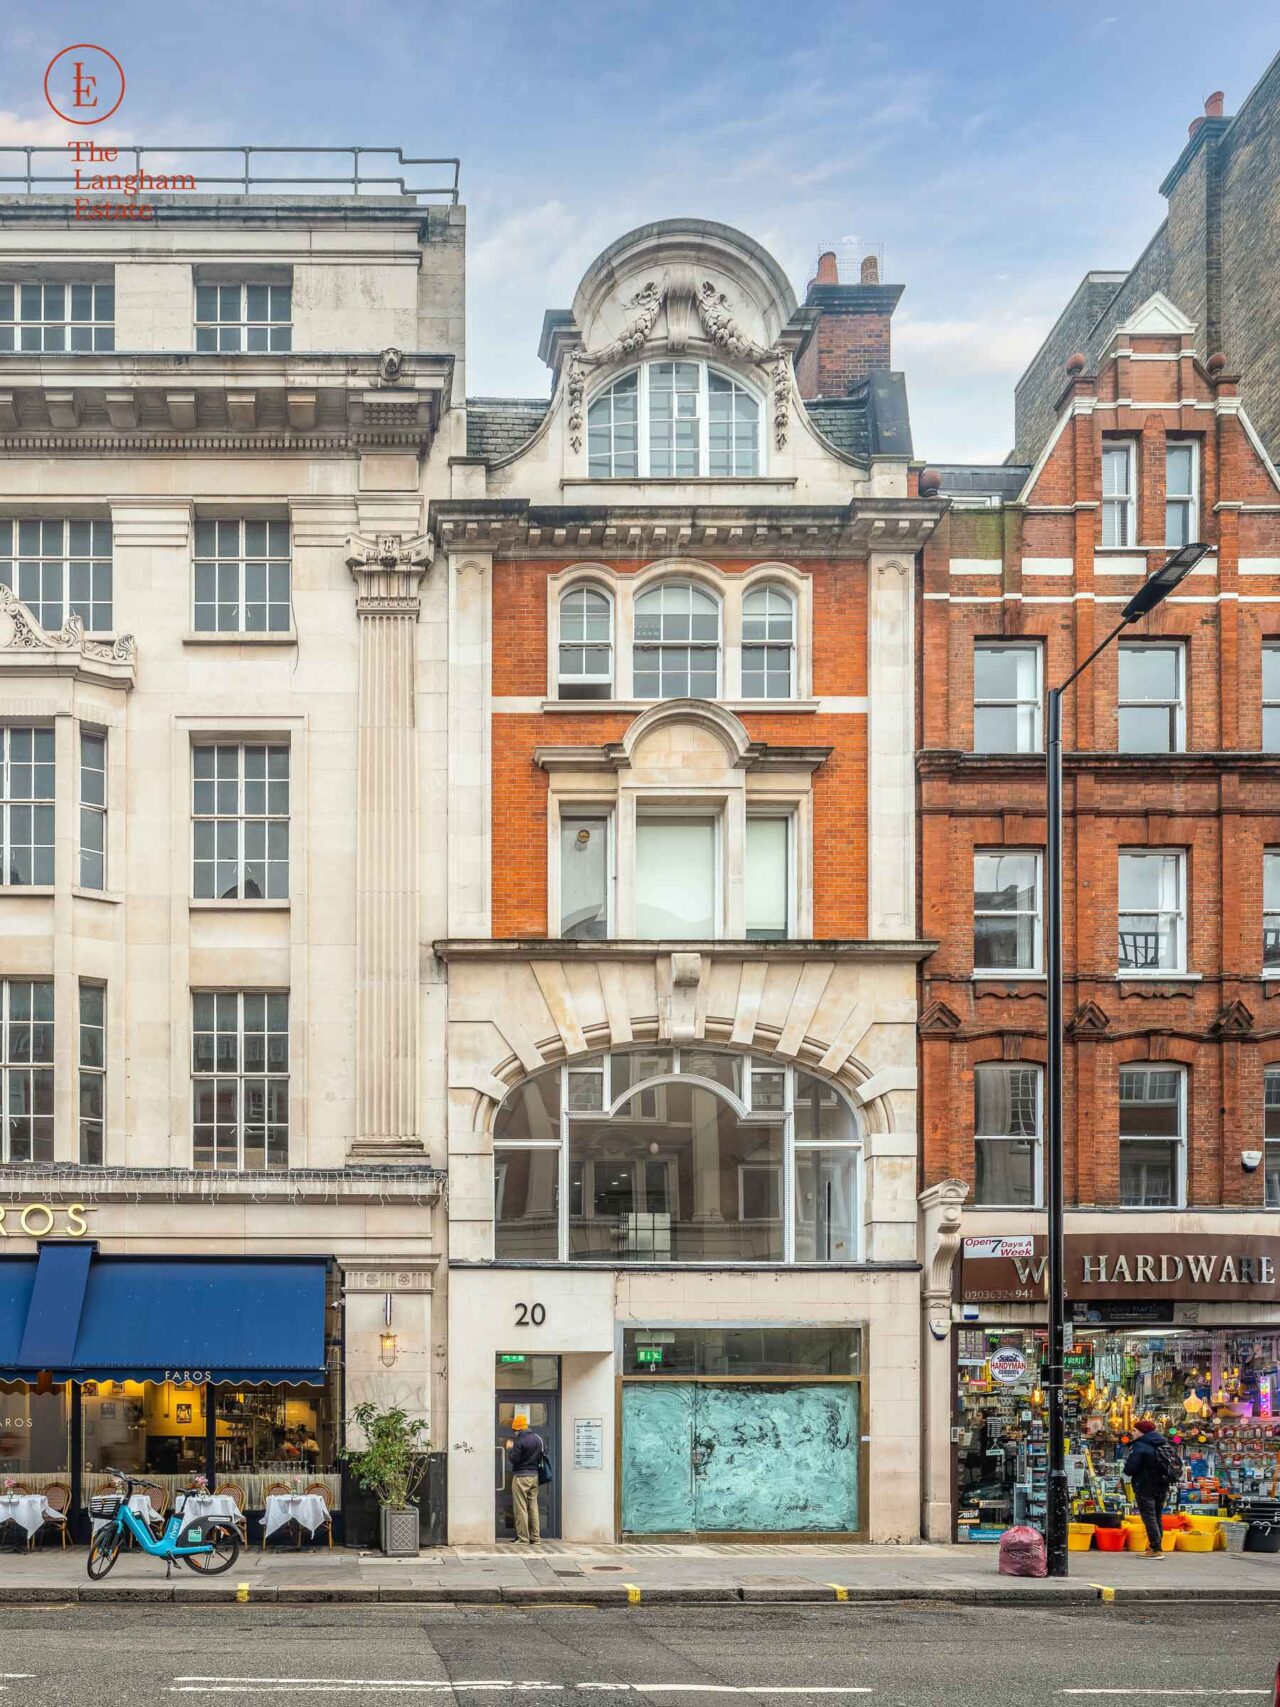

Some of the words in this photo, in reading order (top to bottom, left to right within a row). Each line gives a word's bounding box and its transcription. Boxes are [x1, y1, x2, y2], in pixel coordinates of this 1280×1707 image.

[965, 1238, 992, 1247] Open
[991, 1239, 1002, 1253] 7
[1000, 1241, 1023, 1249] Days
[1000, 1248, 1031, 1256] Week
[1081, 1254, 1276, 1285] HARDWARE
[514, 1302, 546, 1327] 20
[990, 1361, 1026, 1370] HANDYMAN
[164, 1370, 211, 1380] FAROS
[0, 1417, 33, 1428] ROS
